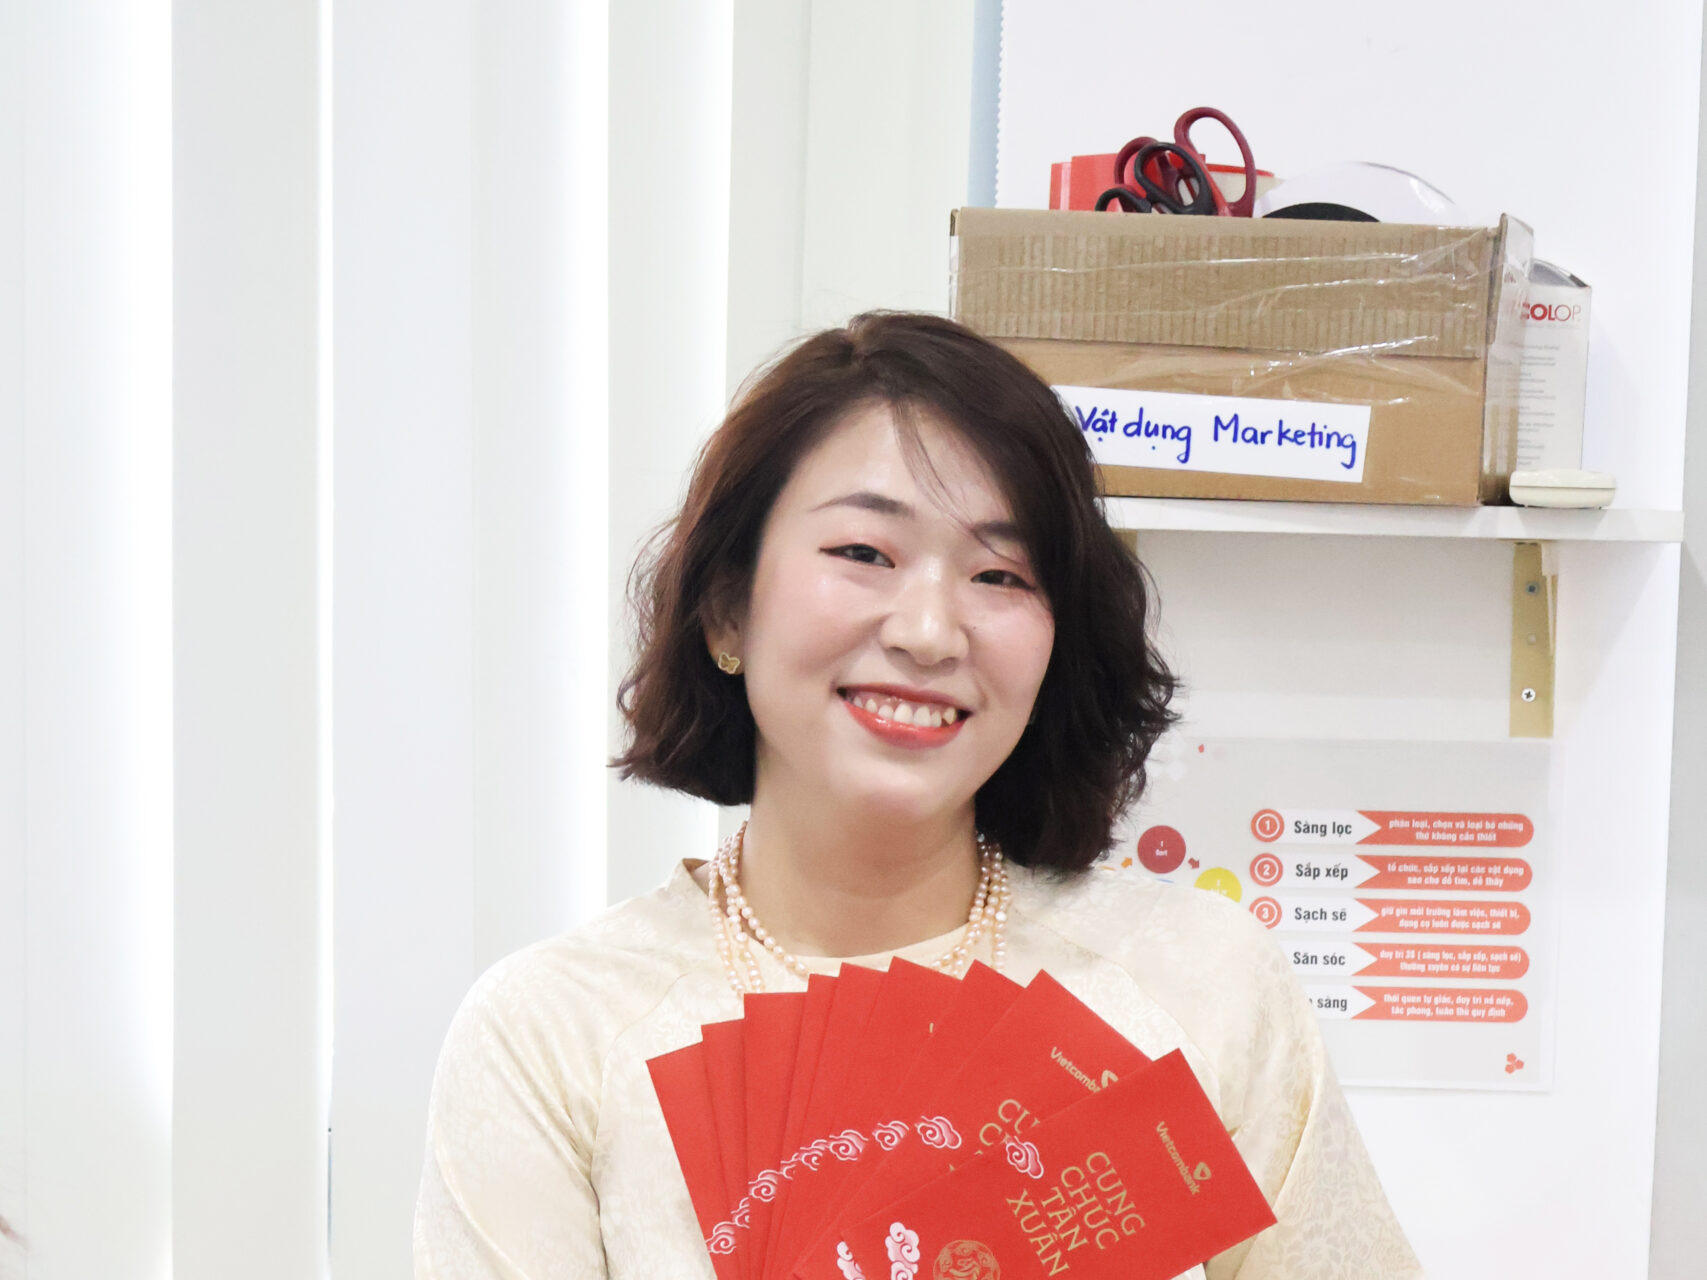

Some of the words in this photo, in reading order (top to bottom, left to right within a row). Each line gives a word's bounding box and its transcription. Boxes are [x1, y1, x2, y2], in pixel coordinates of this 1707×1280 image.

[1076, 406, 1117, 442] Vật
[1123, 407, 1192, 464] dụng
[1213, 413, 1357, 470] Marketing
[1265, 820, 1270, 831] 1
[1294, 820, 1327, 837] Sàng
[1332, 822, 1352, 838] lọc
[1263, 864, 1270, 876] 2
[1296, 862, 1320, 880] Sắp
[1325, 862, 1348, 880] xếp
[1262, 907, 1269, 920] 3
[1294, 907, 1327, 923] Sạch
[1332, 908, 1347, 921] sẽ
[1323, 952, 1346, 966] sóc
[1156, 1121, 1199, 1195] Vietcombank
[1086, 1152, 1146, 1236] CUNG
[1061, 1166, 1120, 1250] CHÚC
[1042, 1186, 1088, 1251] TÂN
[1006, 1190, 1070, 1277] XUÂN
